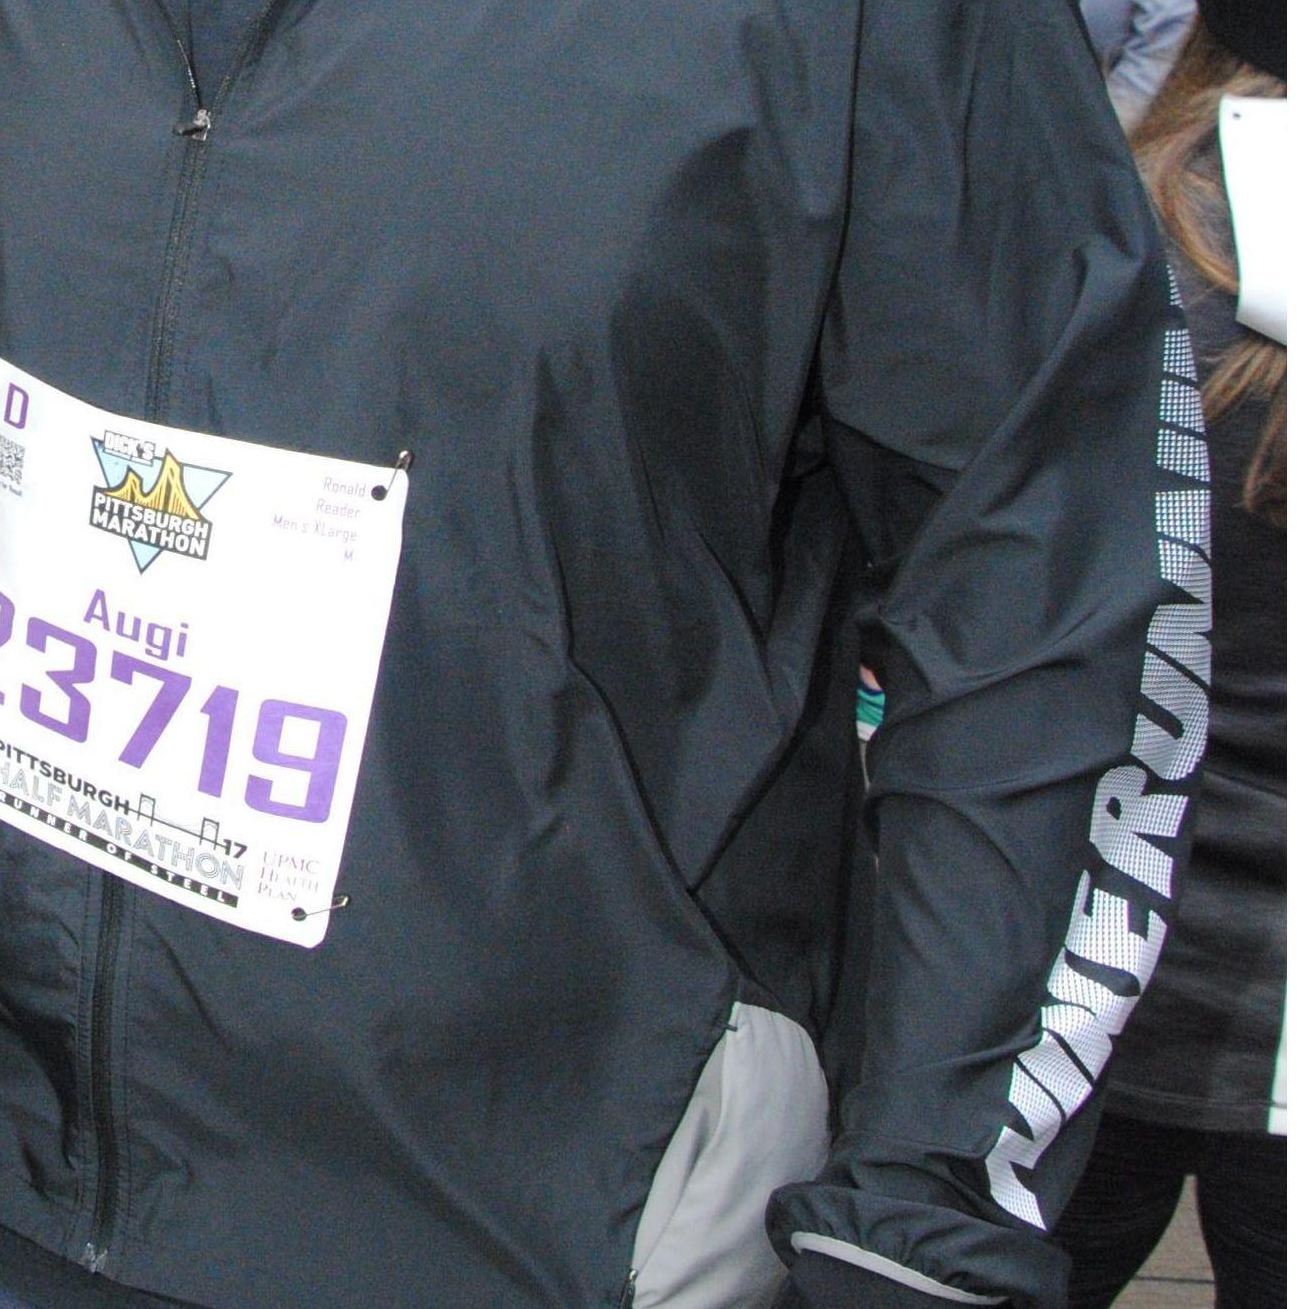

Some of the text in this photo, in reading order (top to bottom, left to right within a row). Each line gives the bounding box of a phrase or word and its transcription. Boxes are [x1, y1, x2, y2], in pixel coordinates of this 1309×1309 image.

[3, 381, 30, 430] D
[93, 508, 206, 557] MARATHON
[94, 492, 209, 539] PITTSBURGH
[83, 588, 190, 661] Augi
[67, 794, 245, 892] MARATHON
[106, 842, 133, 863] OF
[150, 865, 226, 903] STEEL
